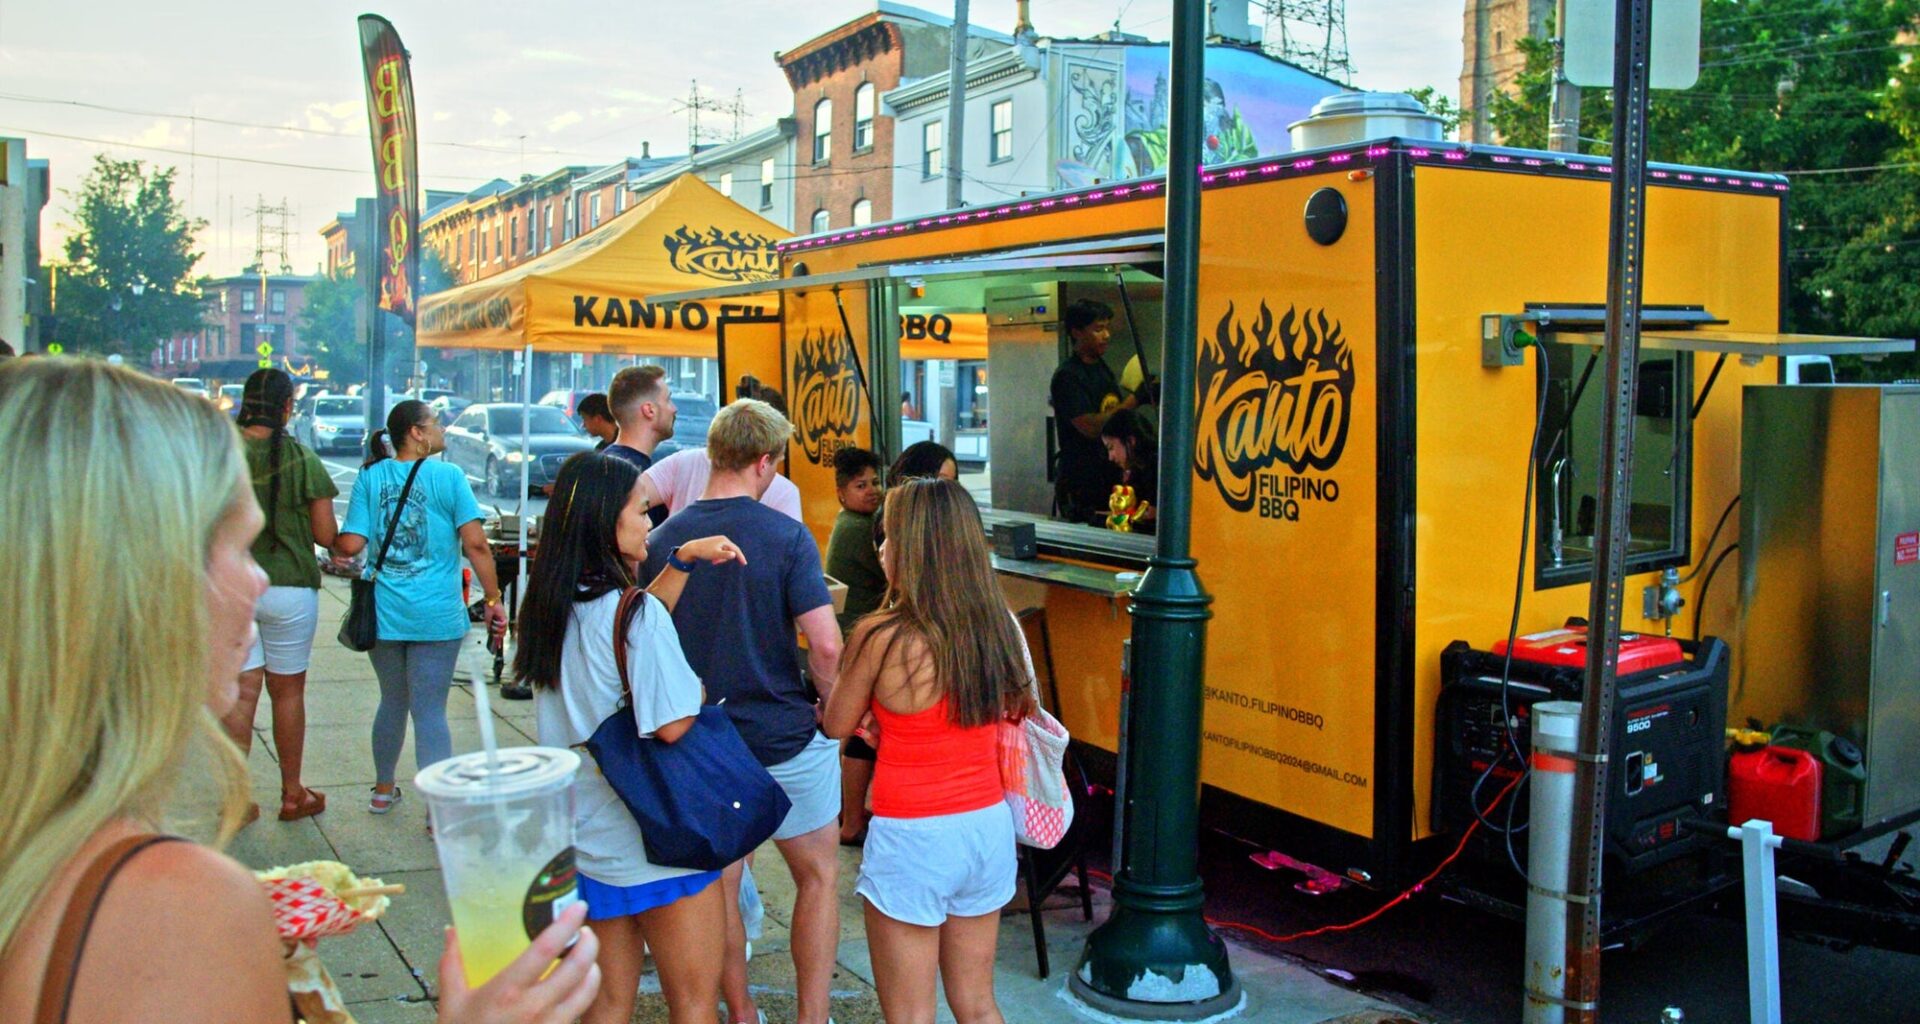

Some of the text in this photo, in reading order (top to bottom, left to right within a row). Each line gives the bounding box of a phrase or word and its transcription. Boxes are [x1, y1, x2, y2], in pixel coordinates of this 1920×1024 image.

[675, 244, 779, 281] Kant
[573, 295, 709, 331] KANTO
[899, 314, 952, 344] BQ
[794, 362, 859, 465] Kanto
[1194, 357, 1347, 508] Kanto
[1259, 474, 1340, 502] FILIPINO
[1259, 497, 1300, 522] BBQ
[1627, 719, 1651, 734] 9500
